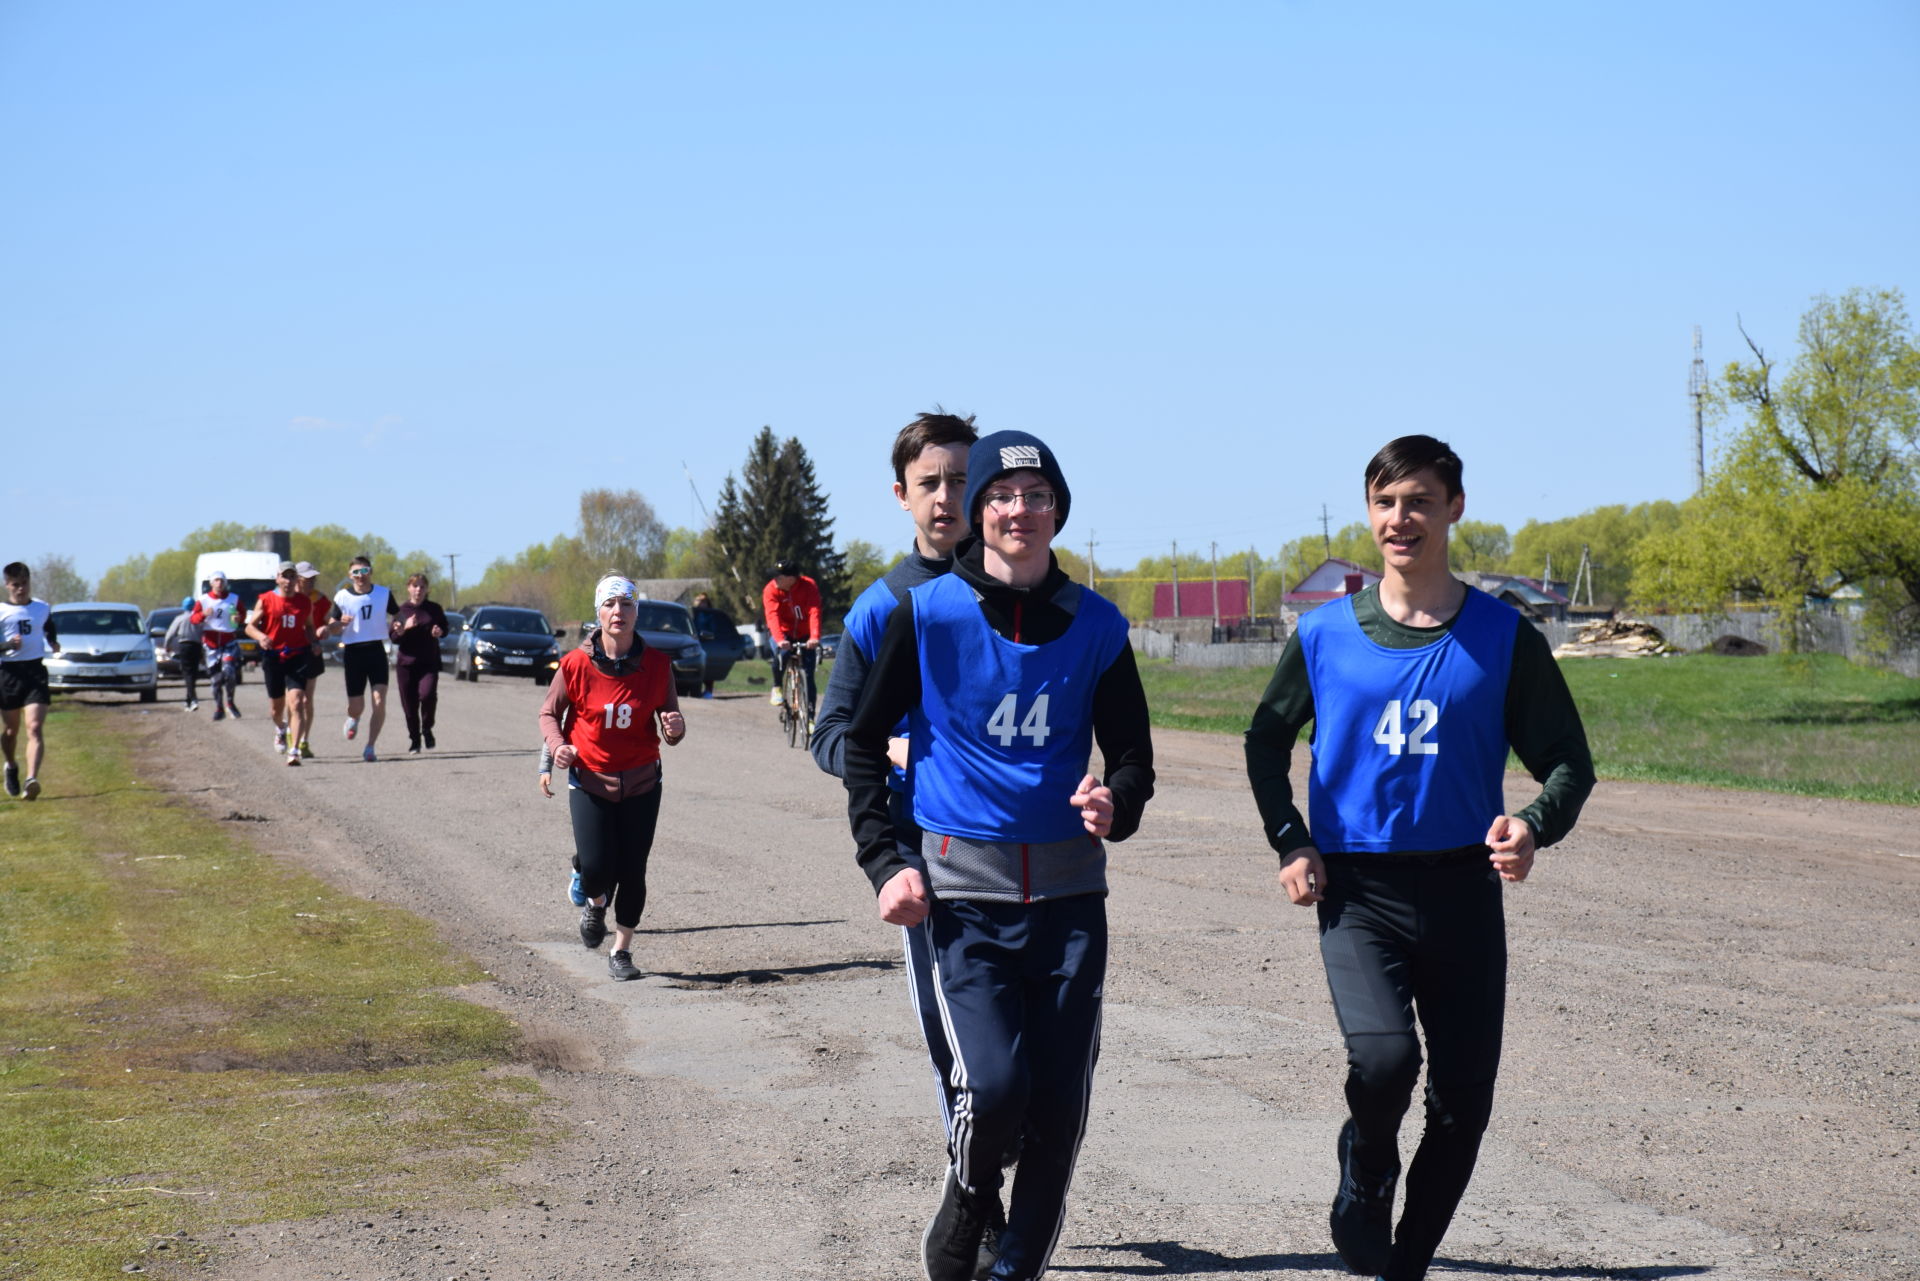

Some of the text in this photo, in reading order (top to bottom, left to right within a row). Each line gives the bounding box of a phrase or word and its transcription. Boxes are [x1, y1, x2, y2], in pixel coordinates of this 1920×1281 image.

[282, 614, 296, 629] 19
[361, 604, 373, 620] 17
[17, 619, 33, 636] 15
[603, 703, 632, 729] 18
[986, 693, 1051, 747] 44
[1372, 699, 1439, 756] 42
